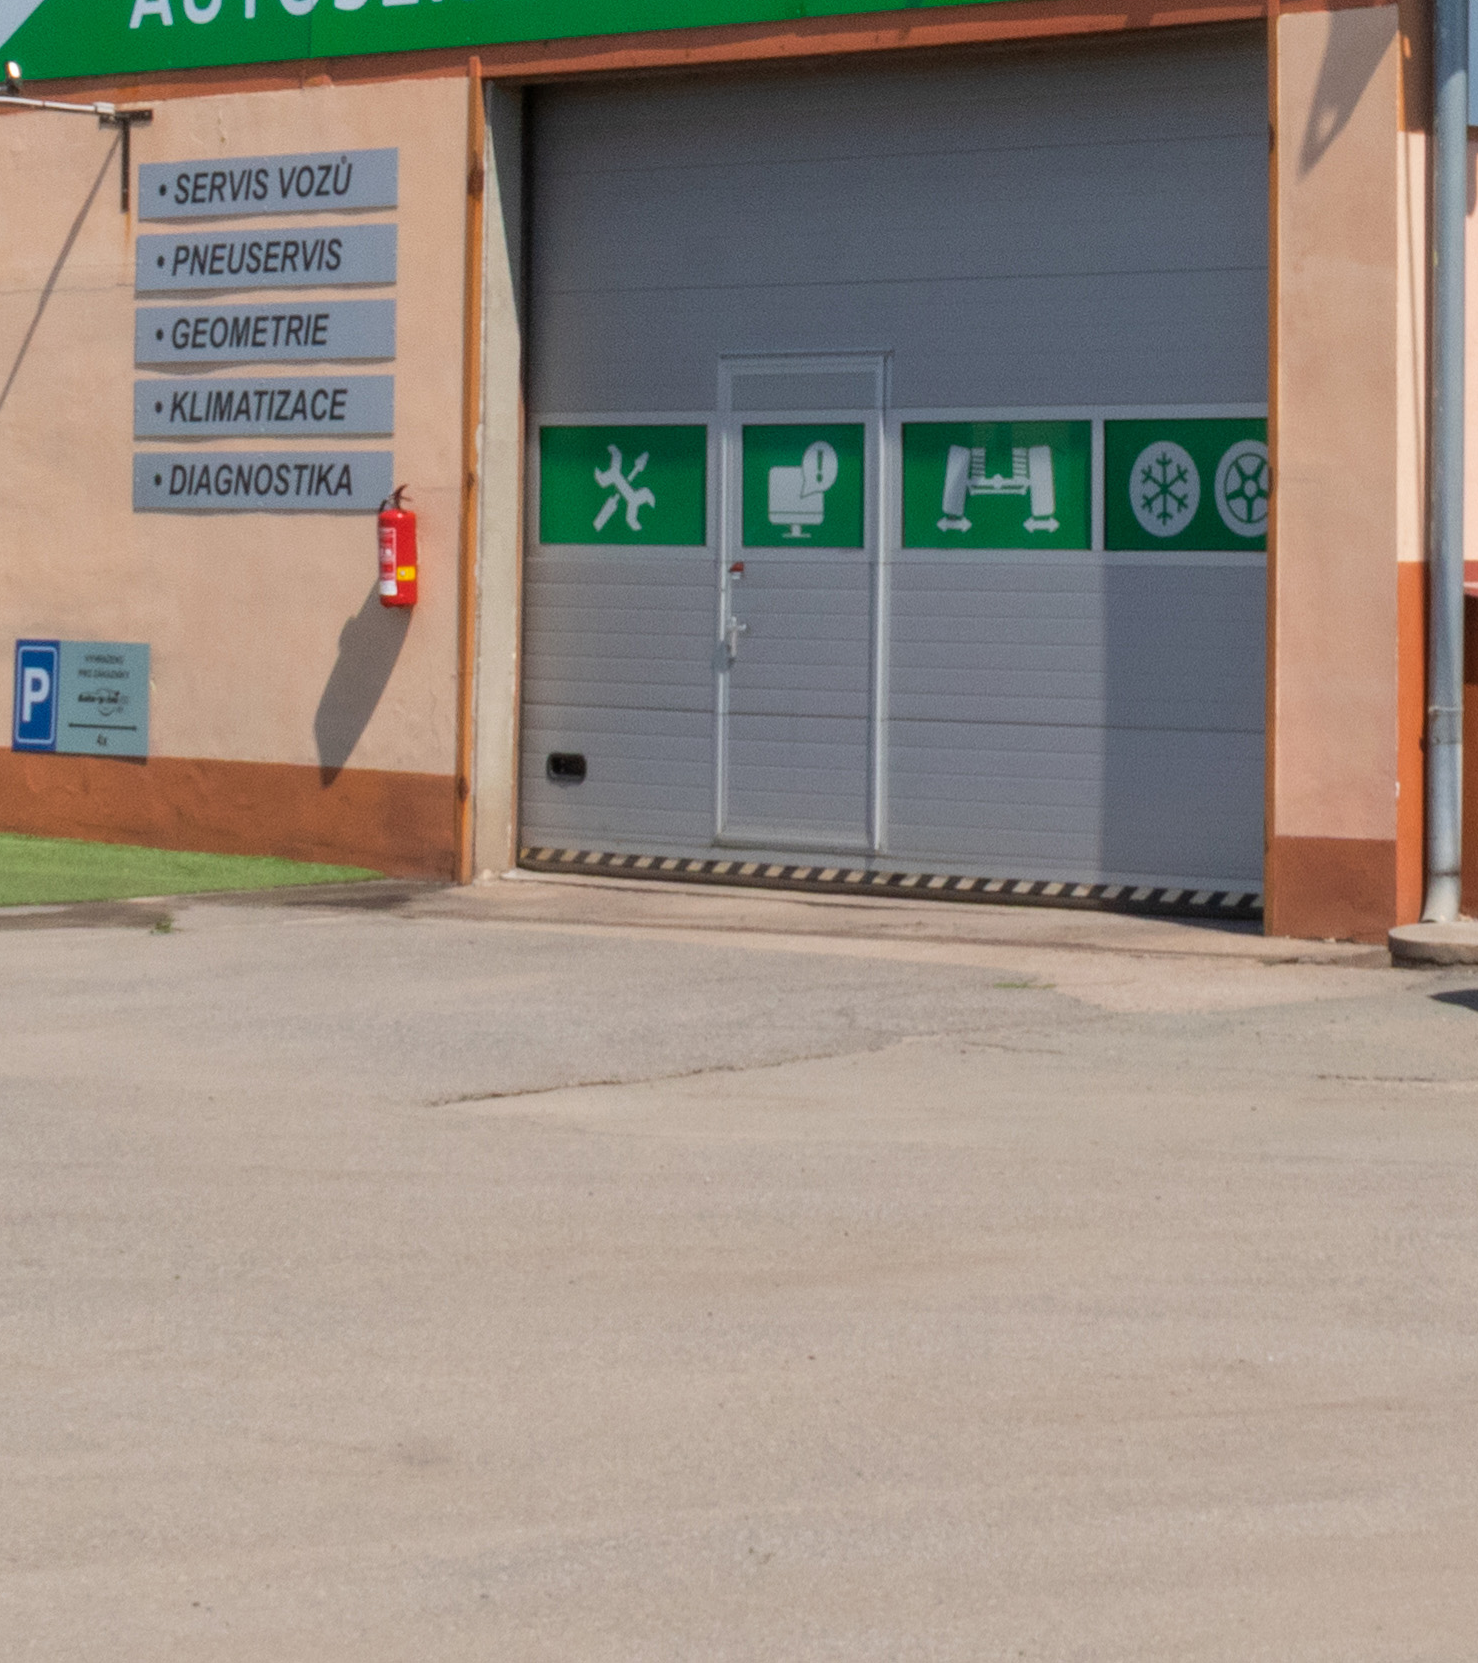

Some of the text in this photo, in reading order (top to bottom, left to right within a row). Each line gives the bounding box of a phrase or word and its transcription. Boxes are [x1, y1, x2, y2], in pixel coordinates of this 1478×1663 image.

[174, 155, 353, 205] SERVIS VOZŮ
[172, 238, 343, 276] PNEUSERVIS
[171, 314, 330, 350] GEOMETRIE
[169, 389, 348, 423] KLIMATIZACE
[168, 463, 353, 496] DIAGNOSTIKA
[22, 667, 50, 724] P
